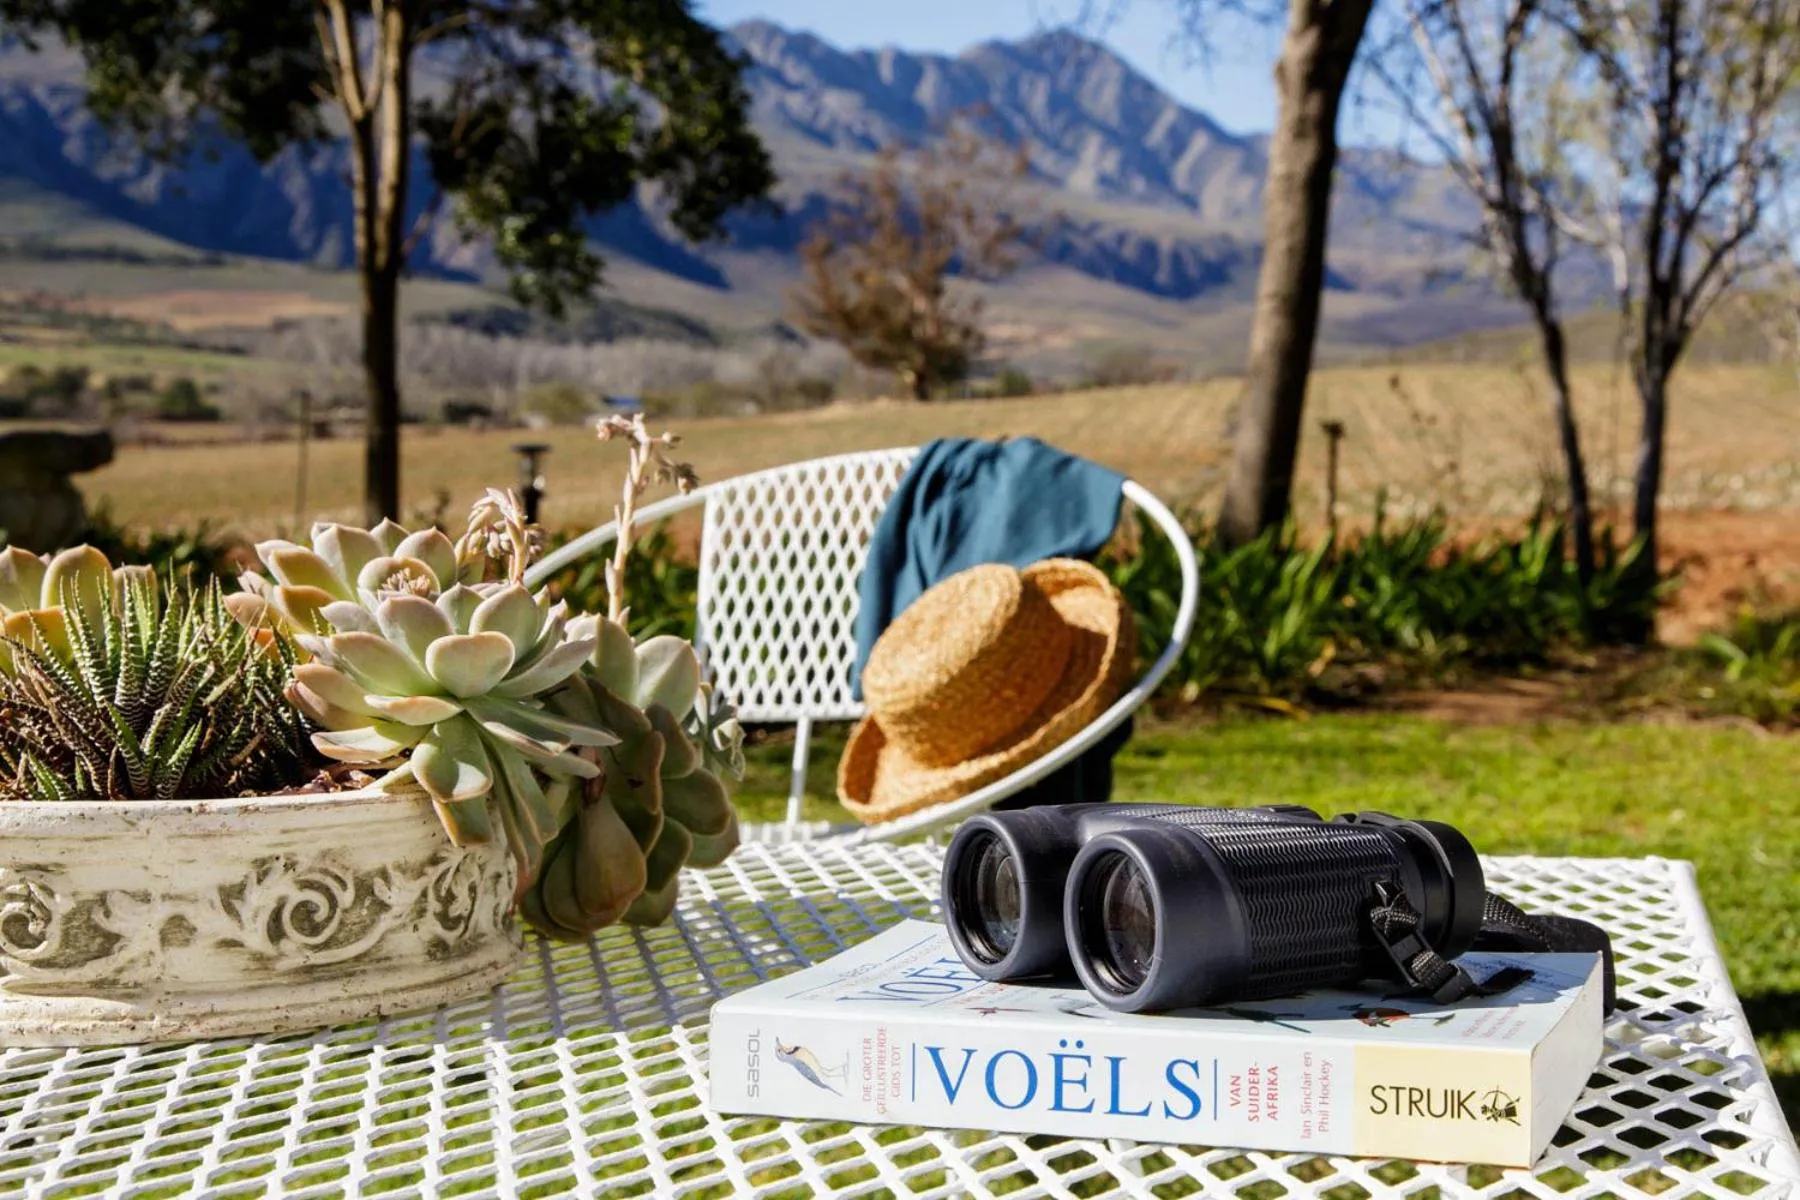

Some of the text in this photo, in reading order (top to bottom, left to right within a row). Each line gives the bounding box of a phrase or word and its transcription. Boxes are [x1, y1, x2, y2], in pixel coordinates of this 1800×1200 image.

[862, 1037, 872, 1102] DIE GROTER
[891, 1045, 901, 1098] GIDS TOT
[924, 1039, 1202, 1121] VOËLS
[1230, 1075, 1241, 1107] VAN
[1247, 1060, 1260, 1123] SUIDER-
[1266, 1065, 1278, 1121] AFRIKA
[1300, 1051, 1312, 1140] Ian Sinclair en
[1317, 1059, 1333, 1133] Phil Hockey
[1370, 1085, 1477, 1121] STRUIK
